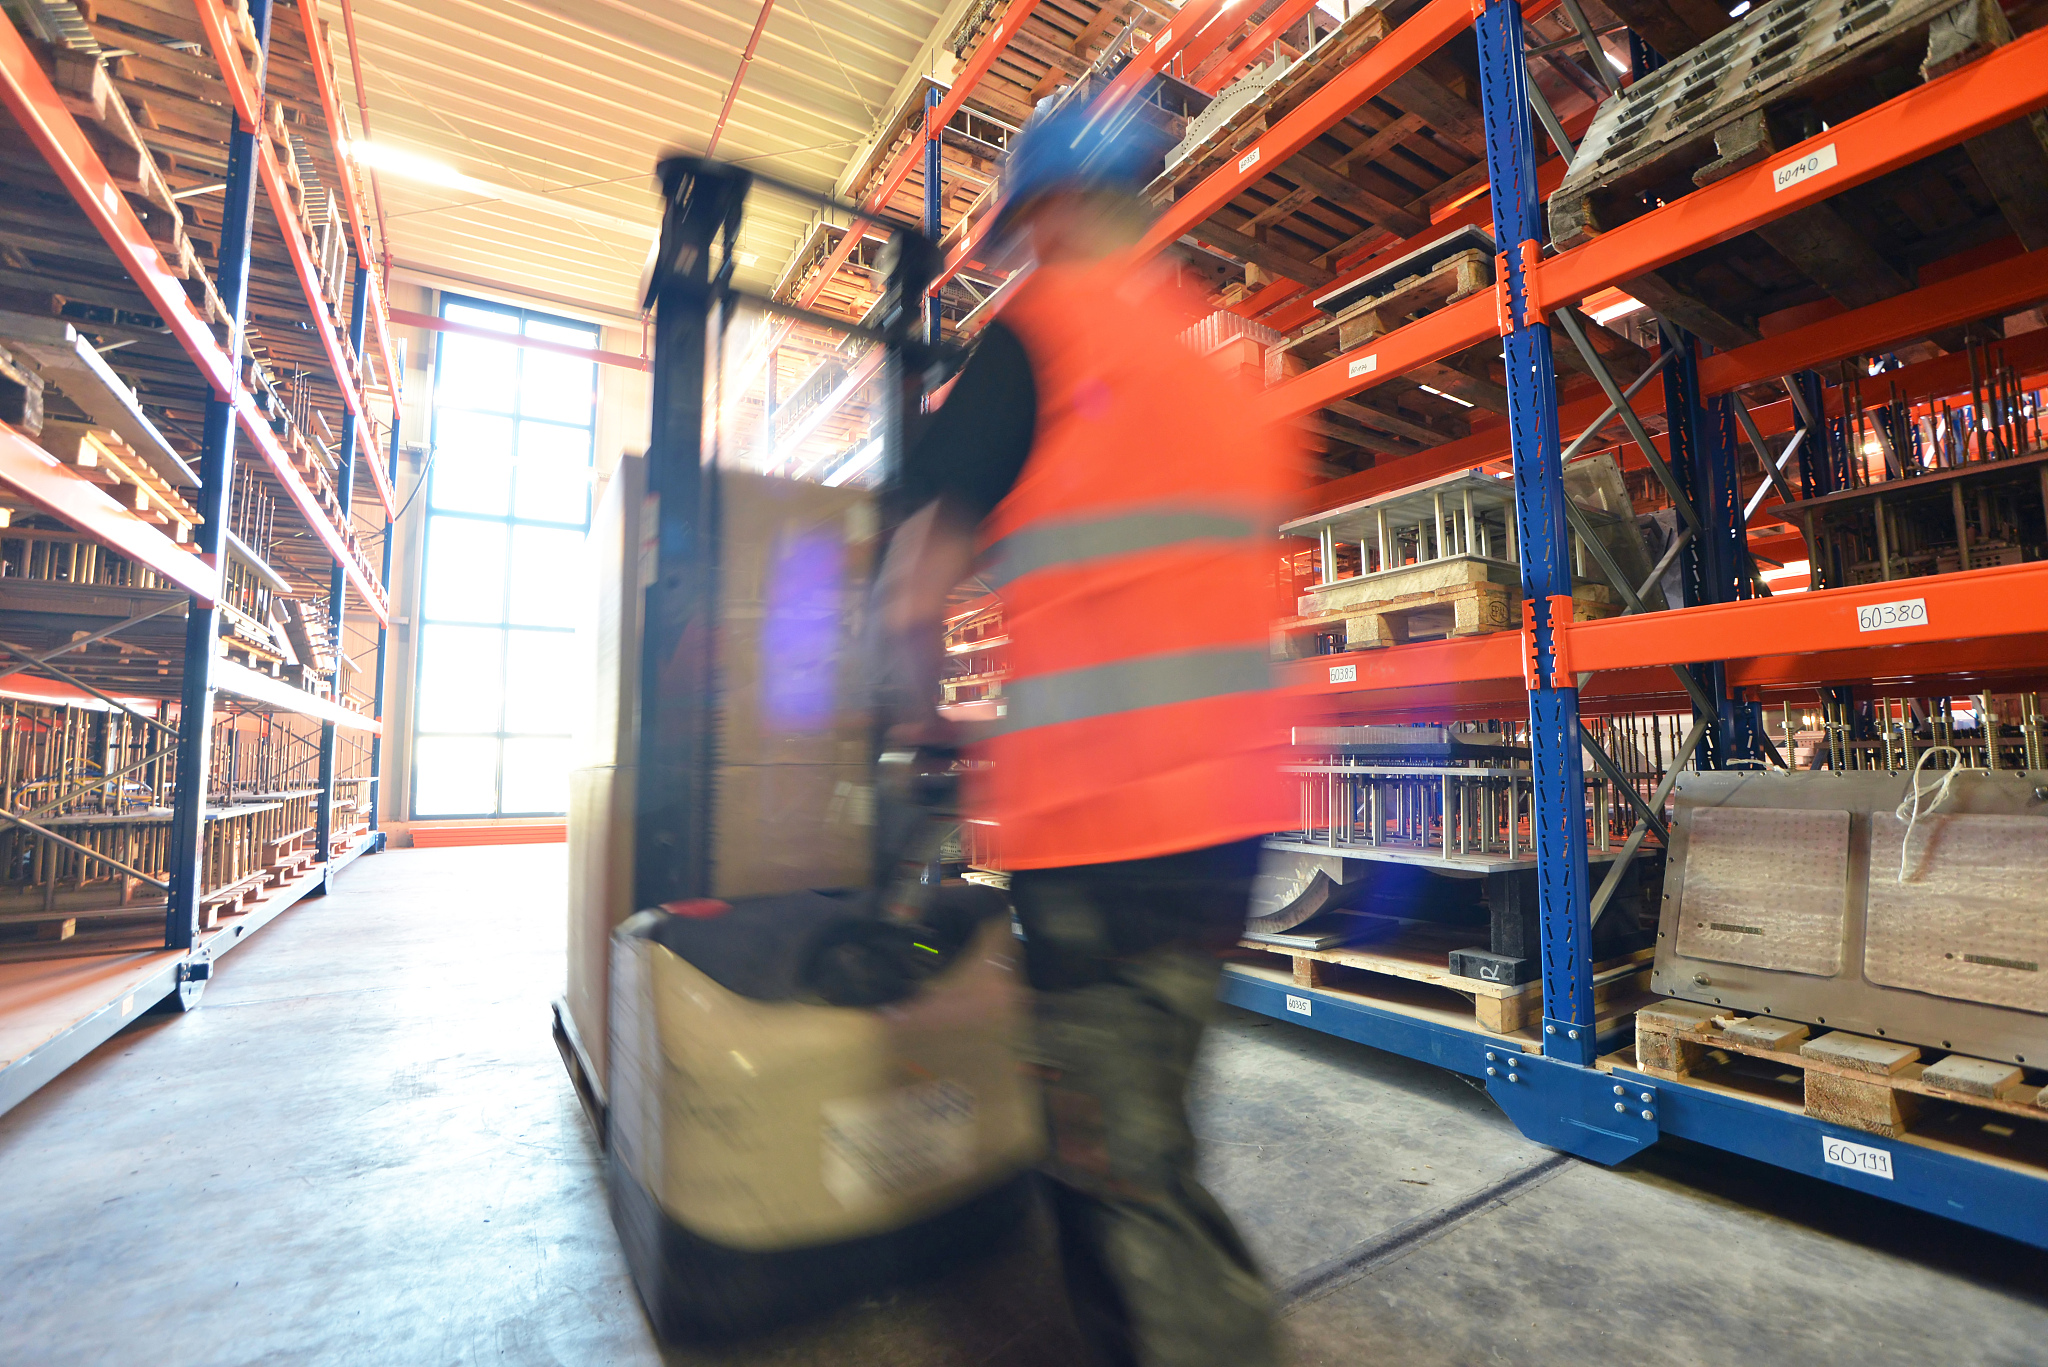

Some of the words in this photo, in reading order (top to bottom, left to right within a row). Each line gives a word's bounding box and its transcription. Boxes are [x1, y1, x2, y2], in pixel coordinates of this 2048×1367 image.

[1778, 157, 1819, 185] 60140
[1860, 604, 1924, 629] 60380
[1330, 667, 1355, 682] 60385
[1288, 998, 1308, 1011] 60335
[1828, 1143, 1888, 1172] 60199
